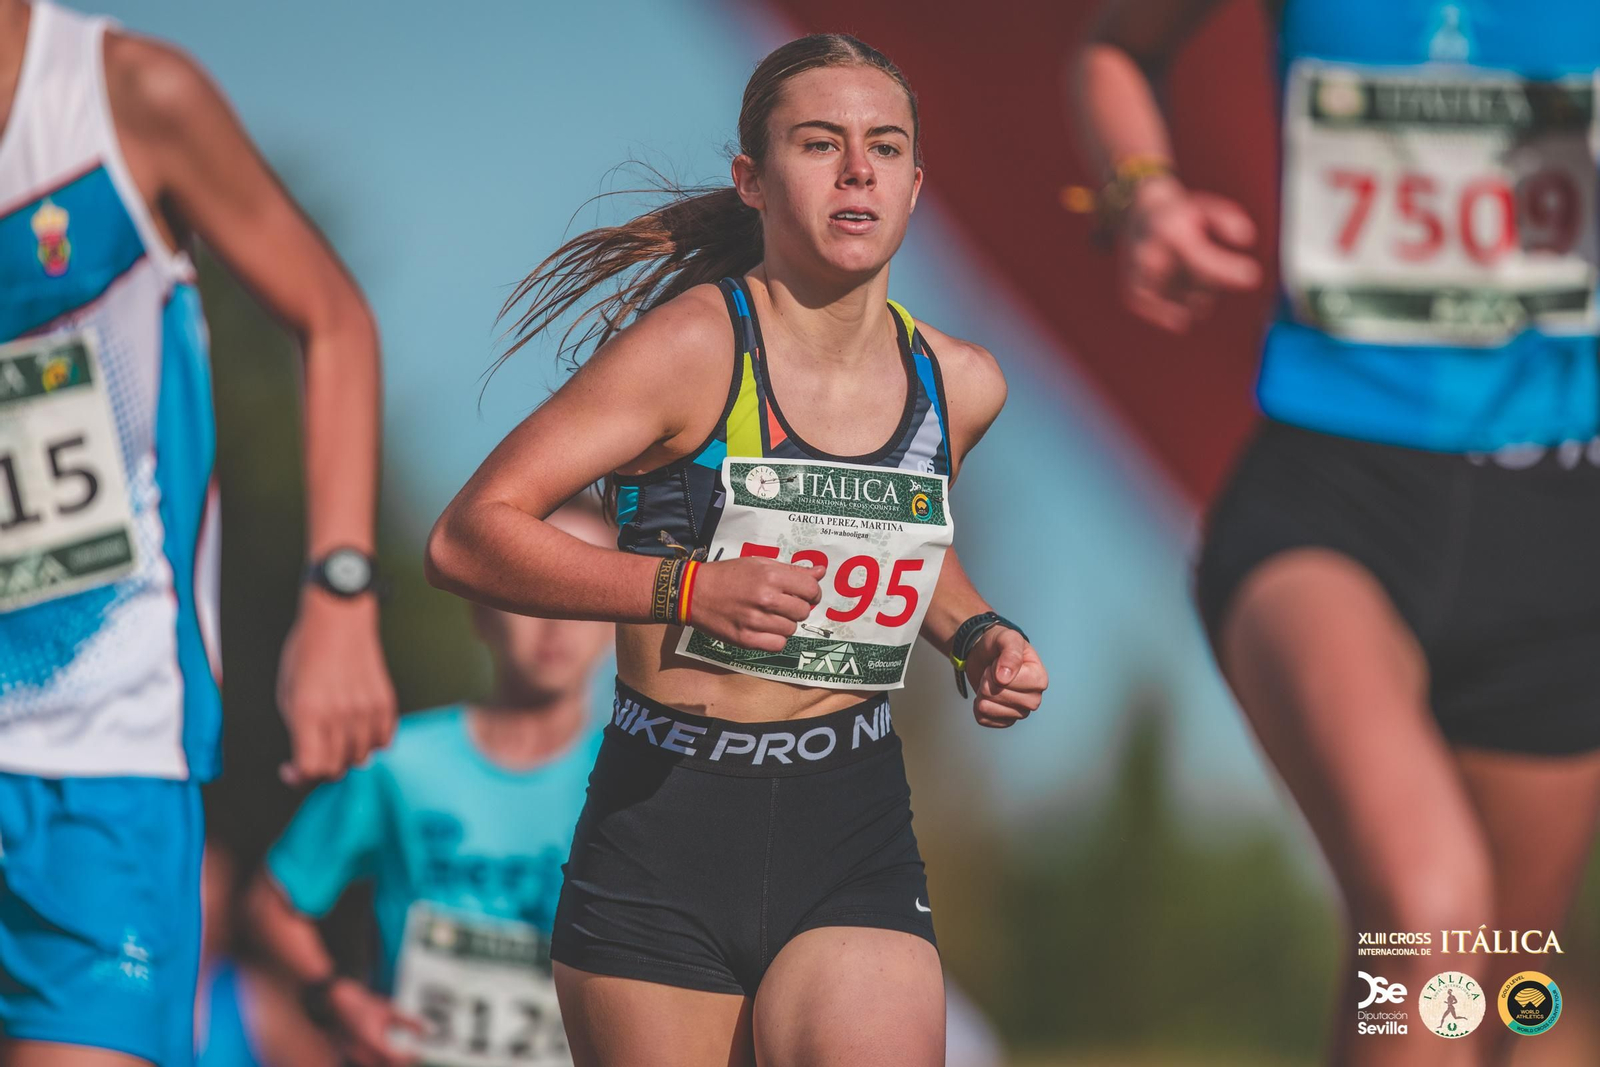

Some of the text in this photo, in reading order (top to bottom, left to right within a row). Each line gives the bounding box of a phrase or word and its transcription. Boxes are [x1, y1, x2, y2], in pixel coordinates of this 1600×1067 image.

[1322, 165, 1582, 269] 7509
[797, 468, 900, 505] ITÁLICA
[788, 513, 904, 532] GARCIA PEREZ, MARTINA
[820, 527, 869, 540] 361-wahooligan
[739, 541, 924, 628] 95
[729, 660, 775, 675] FEDERACIÓN
[776, 669, 815, 681] ANDALUZA
[828, 676, 863, 685] ATLETISMO
[709, 726, 837, 766] PRO
